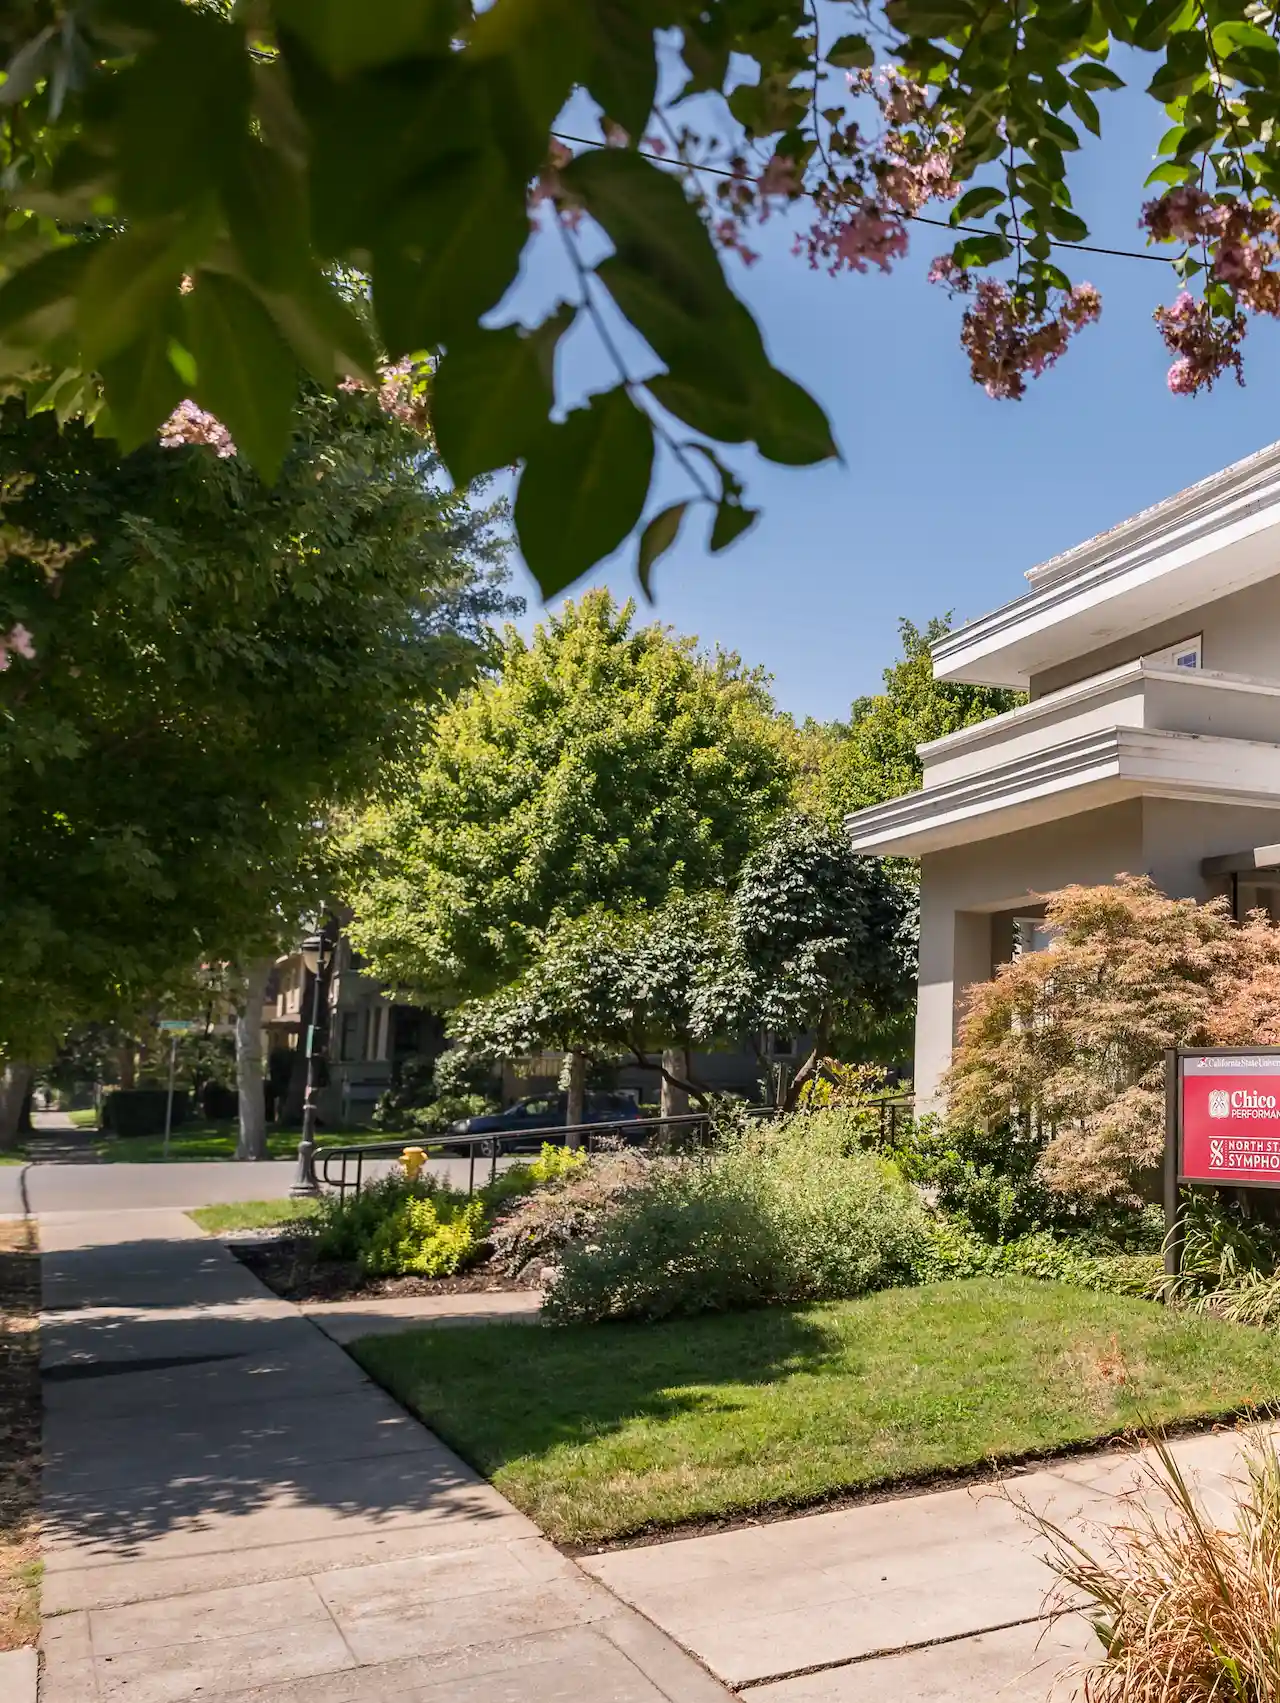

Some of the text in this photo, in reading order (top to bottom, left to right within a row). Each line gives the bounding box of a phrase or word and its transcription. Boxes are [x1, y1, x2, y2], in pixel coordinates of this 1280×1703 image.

[1208, 1058, 1241, 1068] California
[1241, 1058, 1258, 1068] State
[1231, 1090, 1276, 1109] Chico
[1228, 1141, 1264, 1152] NORTH
